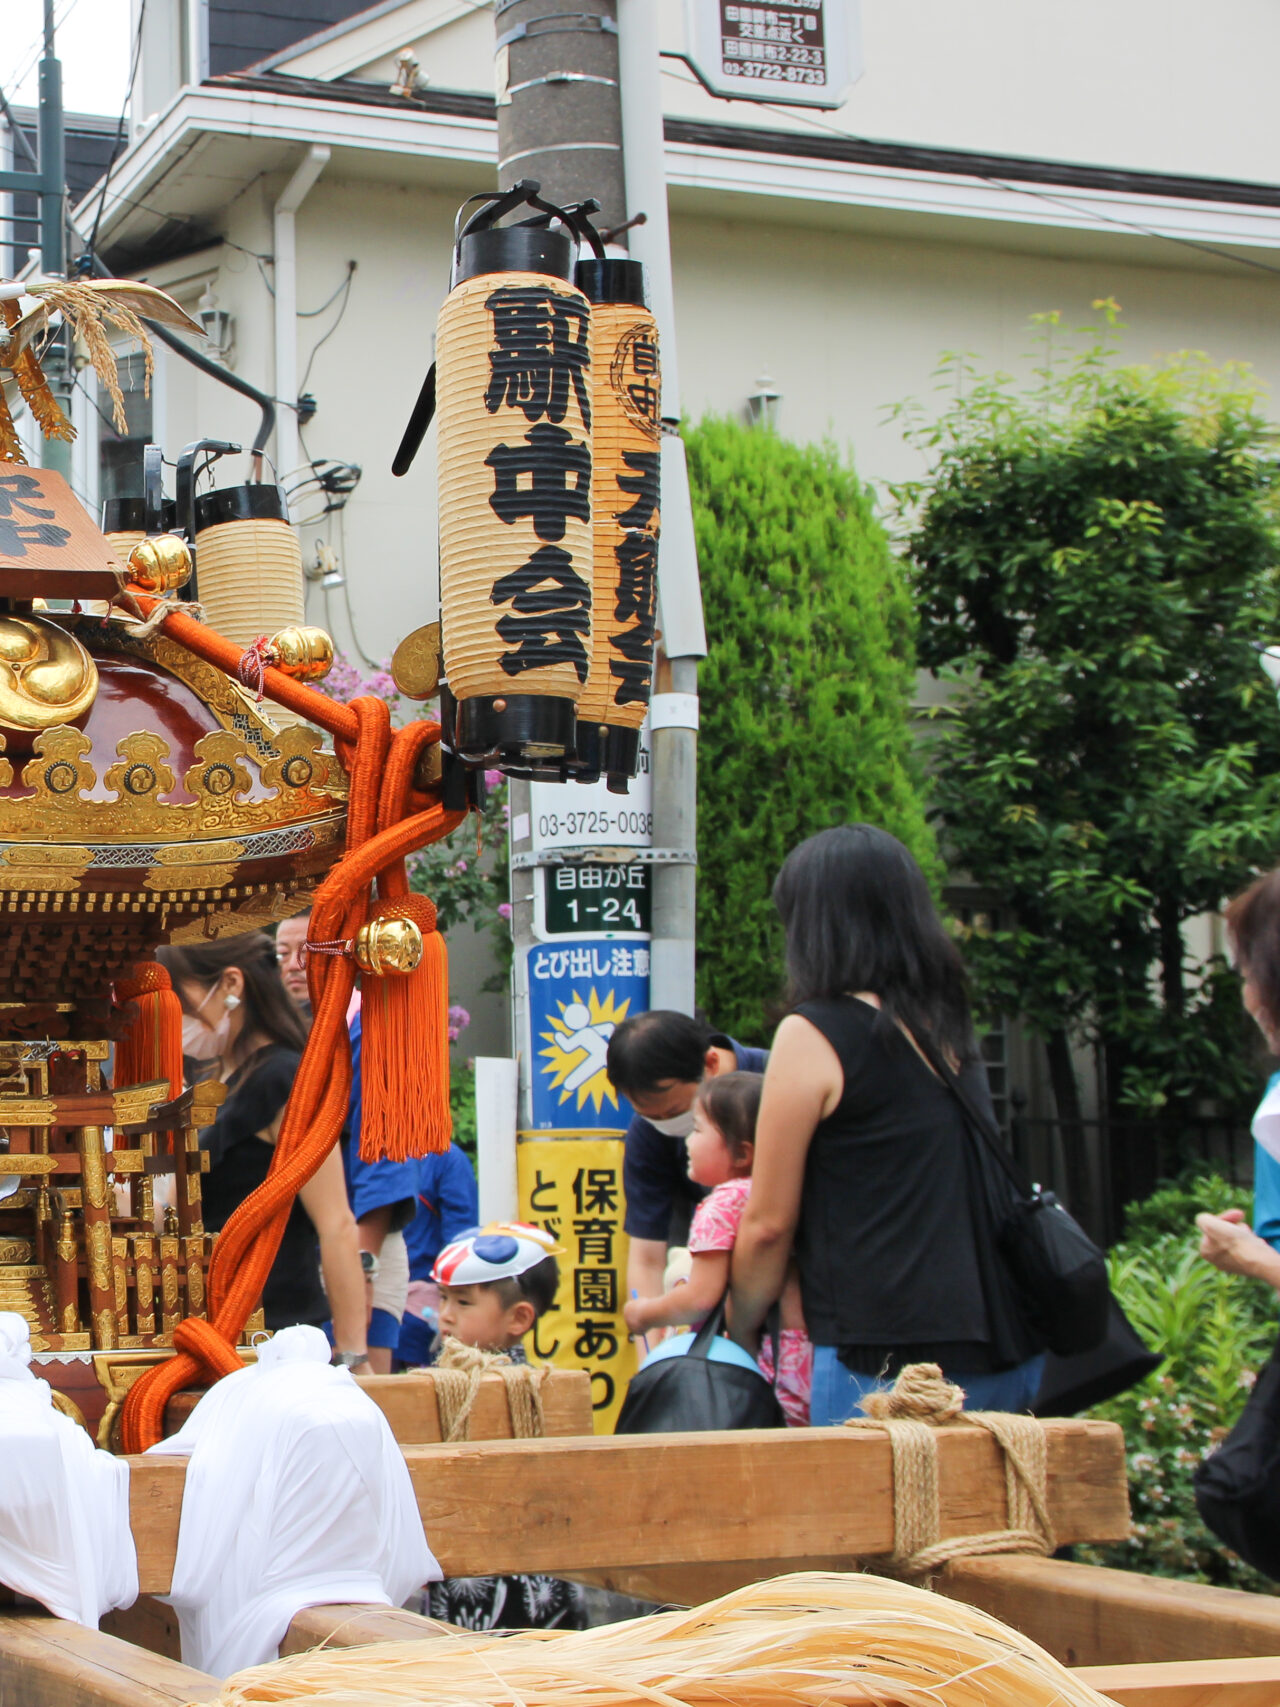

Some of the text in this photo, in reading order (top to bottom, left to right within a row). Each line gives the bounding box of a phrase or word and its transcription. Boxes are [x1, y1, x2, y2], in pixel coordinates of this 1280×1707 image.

[724, 61, 825, 85] 03-3722-8733
[556, 866, 646, 891] 自由が丘
[566, 897, 641, 928] 1-24
[534, 947, 650, 979] とび出し注意
